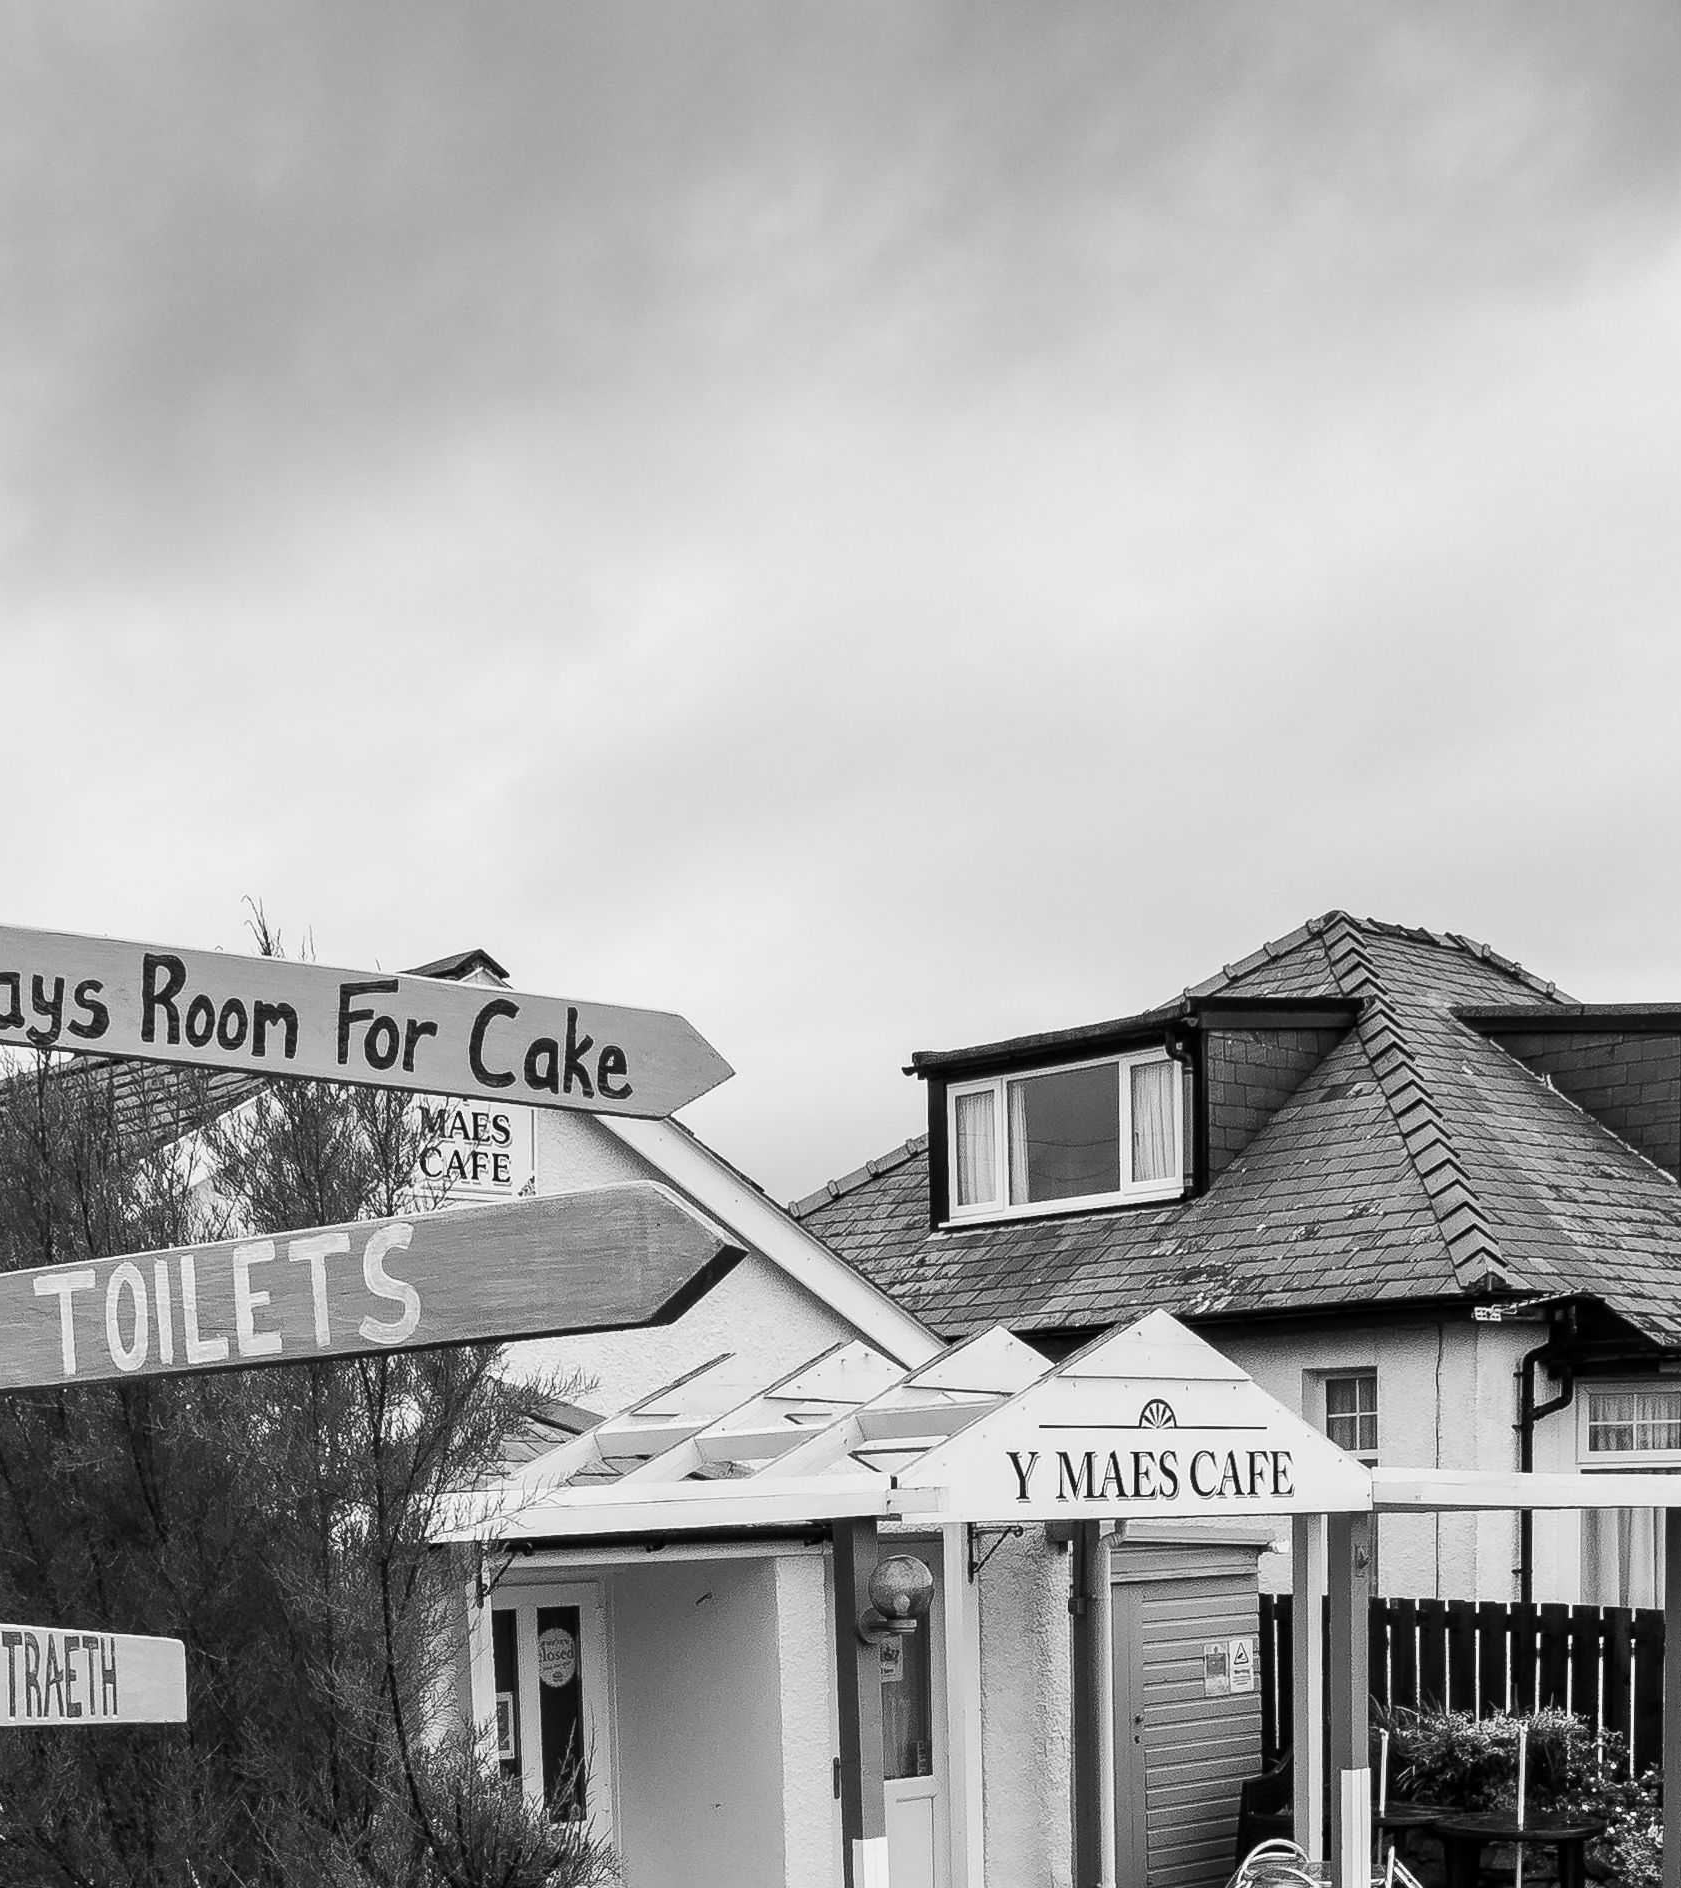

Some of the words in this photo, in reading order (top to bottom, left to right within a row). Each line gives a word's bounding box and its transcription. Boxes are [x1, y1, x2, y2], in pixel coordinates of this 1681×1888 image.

[140, 951, 299, 1059] Room
[337, 978, 440, 1074] For
[468, 1000, 634, 1101] Cake
[419, 1107, 512, 1147] MAES
[419, 1147, 512, 1187] CAFE
[33, 1220, 424, 1379] TOILETS
[1006, 1450, 1040, 1503] Y
[1055, 1449, 1181, 1502] MAES
[1189, 1449, 1296, 1499] CAFE
[0, 1628, 120, 1722] TRAETH
